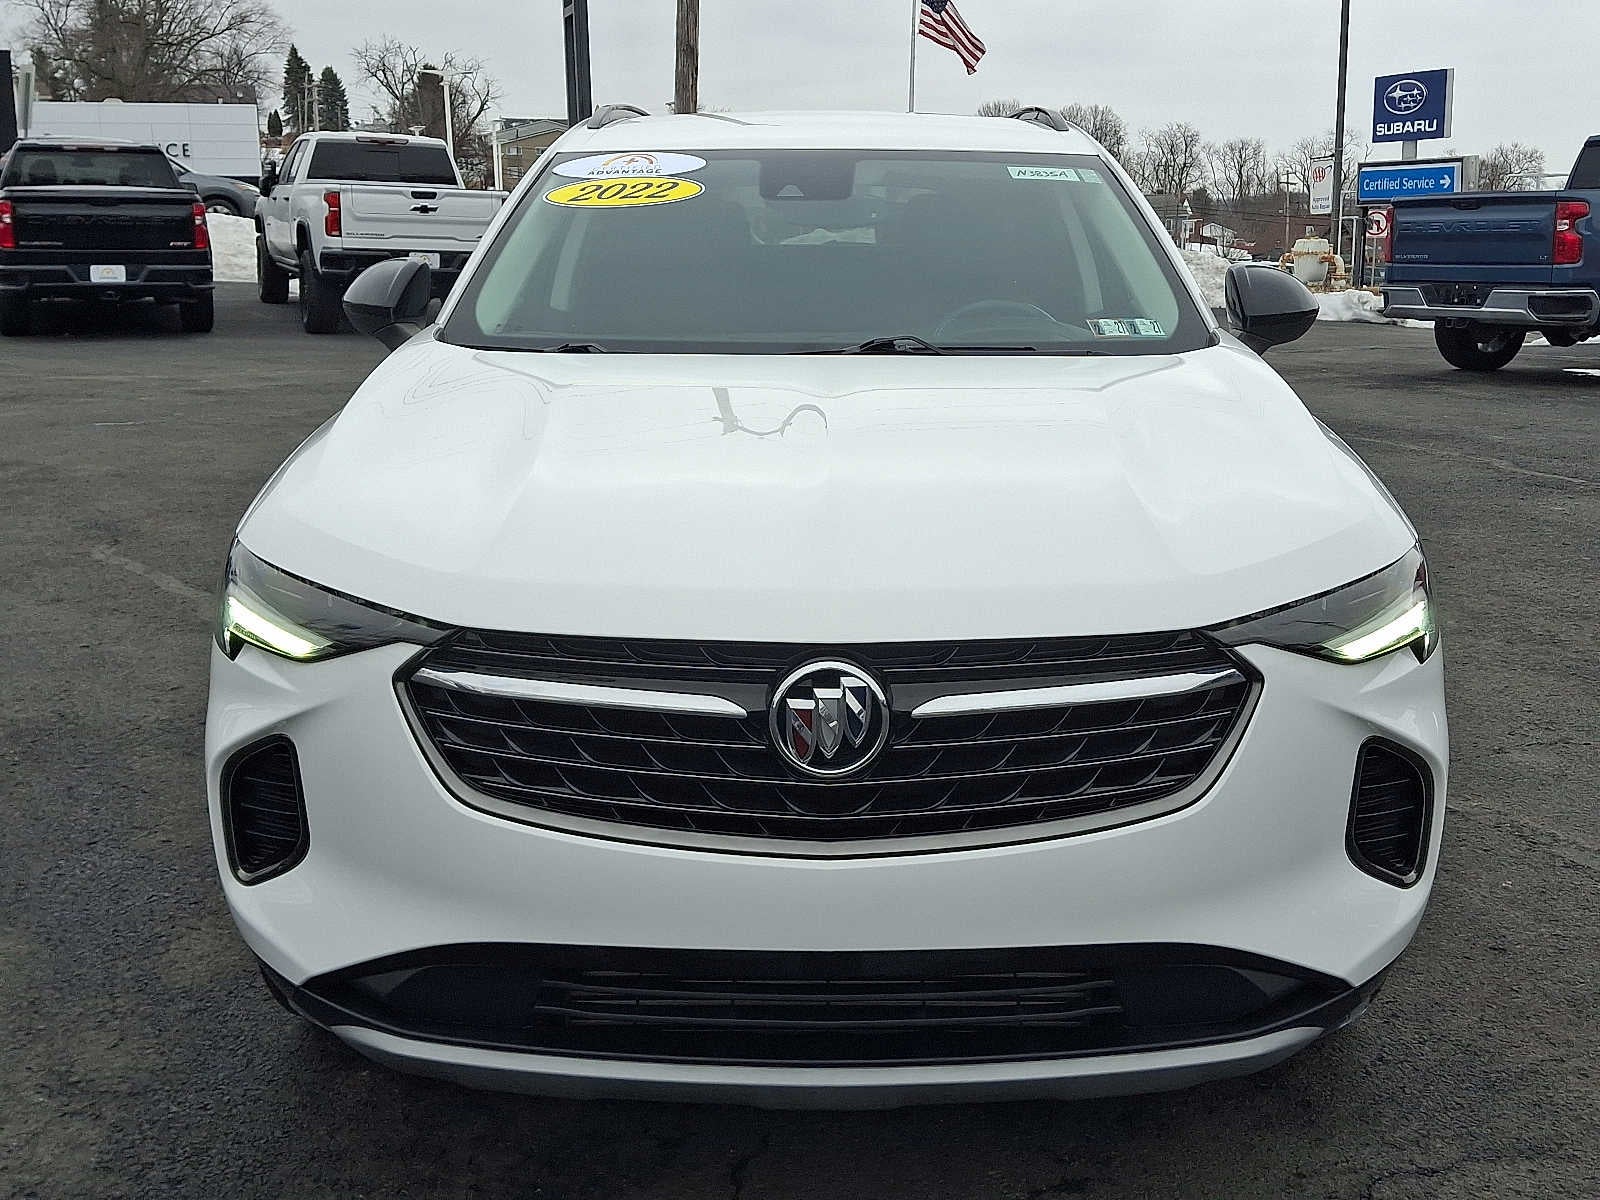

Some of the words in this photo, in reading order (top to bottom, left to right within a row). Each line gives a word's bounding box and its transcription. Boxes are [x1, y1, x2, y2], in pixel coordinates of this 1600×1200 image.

[1375, 118, 1438, 136] SUBARU
[587, 168, 663, 176] ADVANTAGE
[1363, 177, 1400, 191] Certified
[1402, 176, 1435, 190] Service
[567, 182, 680, 202] 2022
